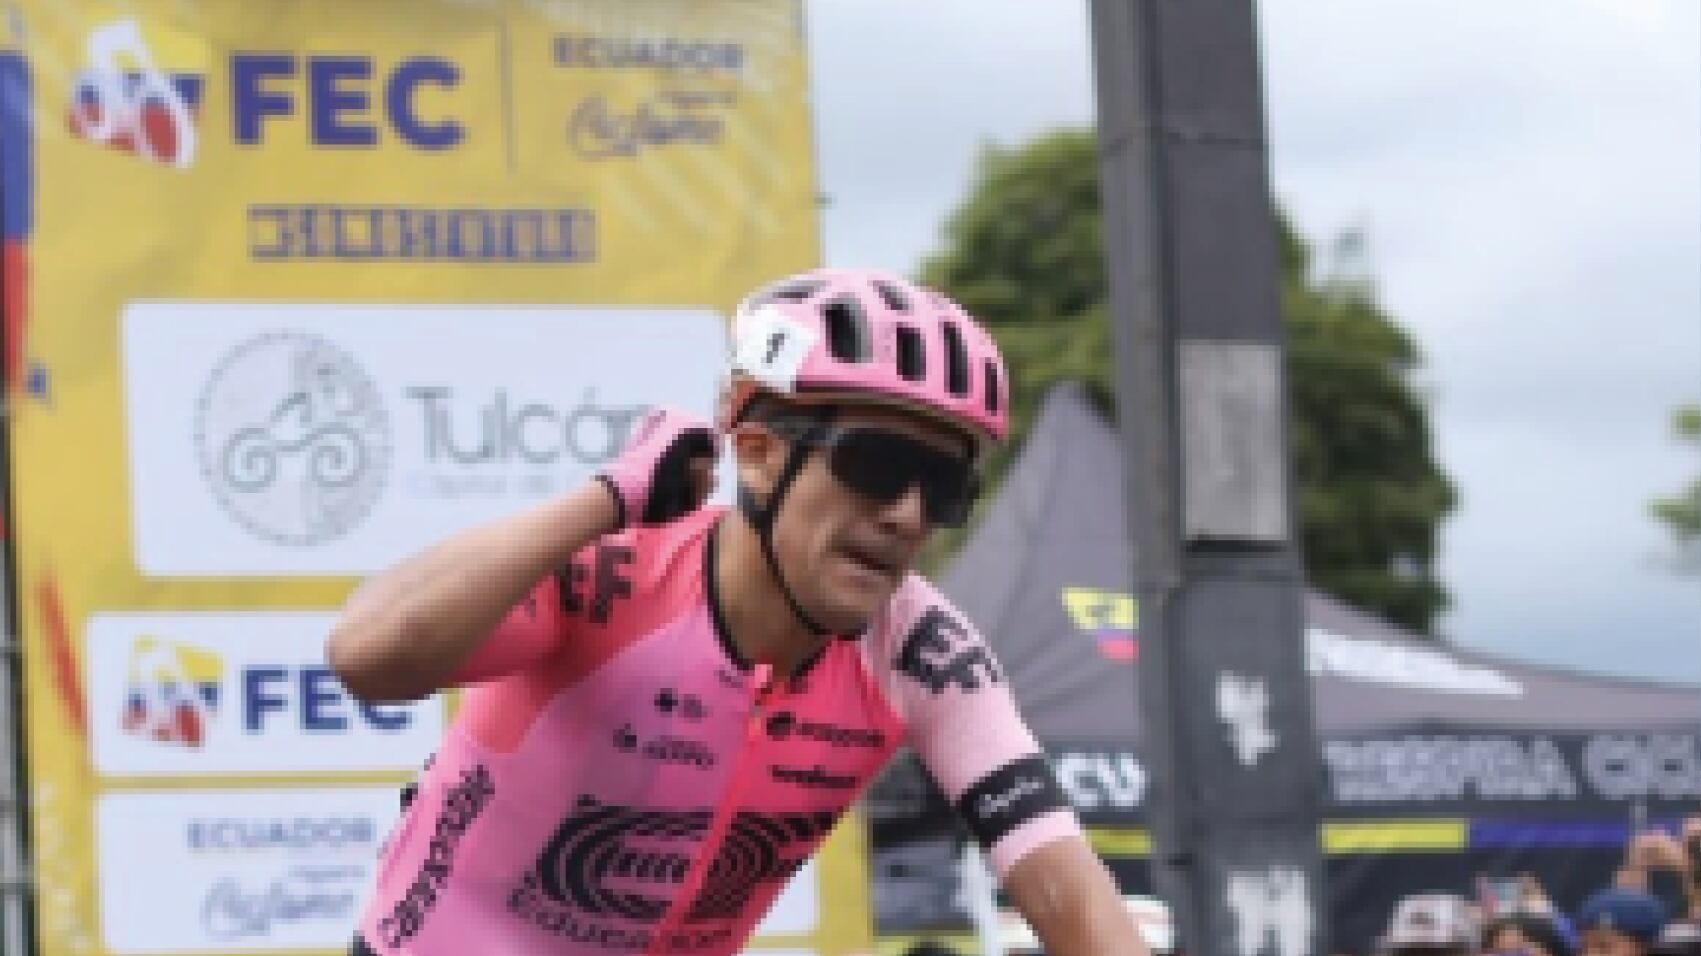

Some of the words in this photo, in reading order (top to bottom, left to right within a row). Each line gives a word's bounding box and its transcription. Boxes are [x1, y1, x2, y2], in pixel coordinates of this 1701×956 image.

[553, 35, 745, 70] ECUADOR
[228, 52, 468, 150] FEC
[184, 816, 379, 853] ECUADOR
